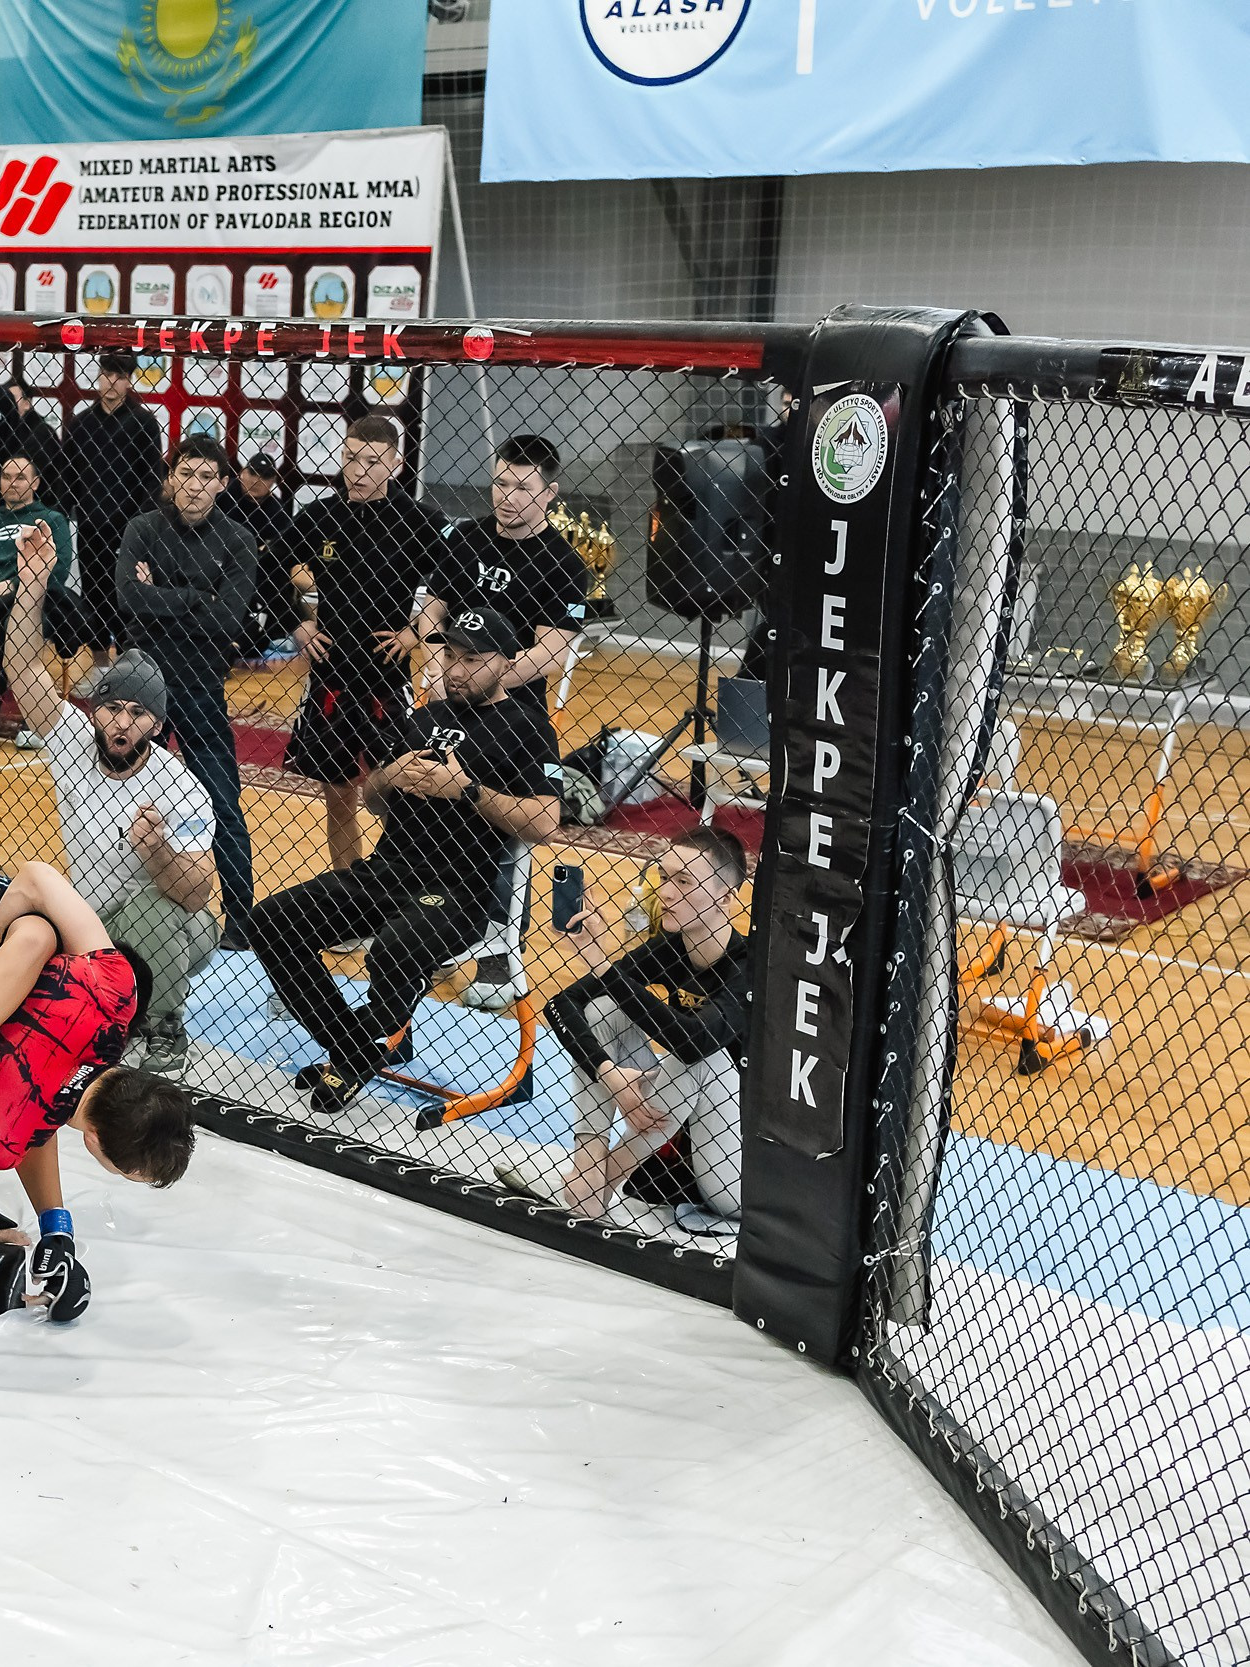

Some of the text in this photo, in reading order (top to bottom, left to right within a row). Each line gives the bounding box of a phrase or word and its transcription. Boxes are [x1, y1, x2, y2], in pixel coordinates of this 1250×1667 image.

[620, 20, 706, 34] VOLLEYBALL
[79, 154, 277, 177] MIXED MARTIAL ARTS
[77, 178, 421, 205] (AMATEUR AND PROFESSIONAL MMA)
[78, 210, 393, 231] FEDERATION OF PAVLODAR REGION
[373, 284, 415, 295] DIZAIN
[131, 320, 407, 359] JEKPE JEK
[833, 397, 859, 414] ULTTYQ
[860, 398, 879, 417] SPORT
[824, 484, 865, 501] PAVLODAR OBLYSY
[807, 519, 849, 870] JEKPE
[788, 911, 825, 1110] JEK
